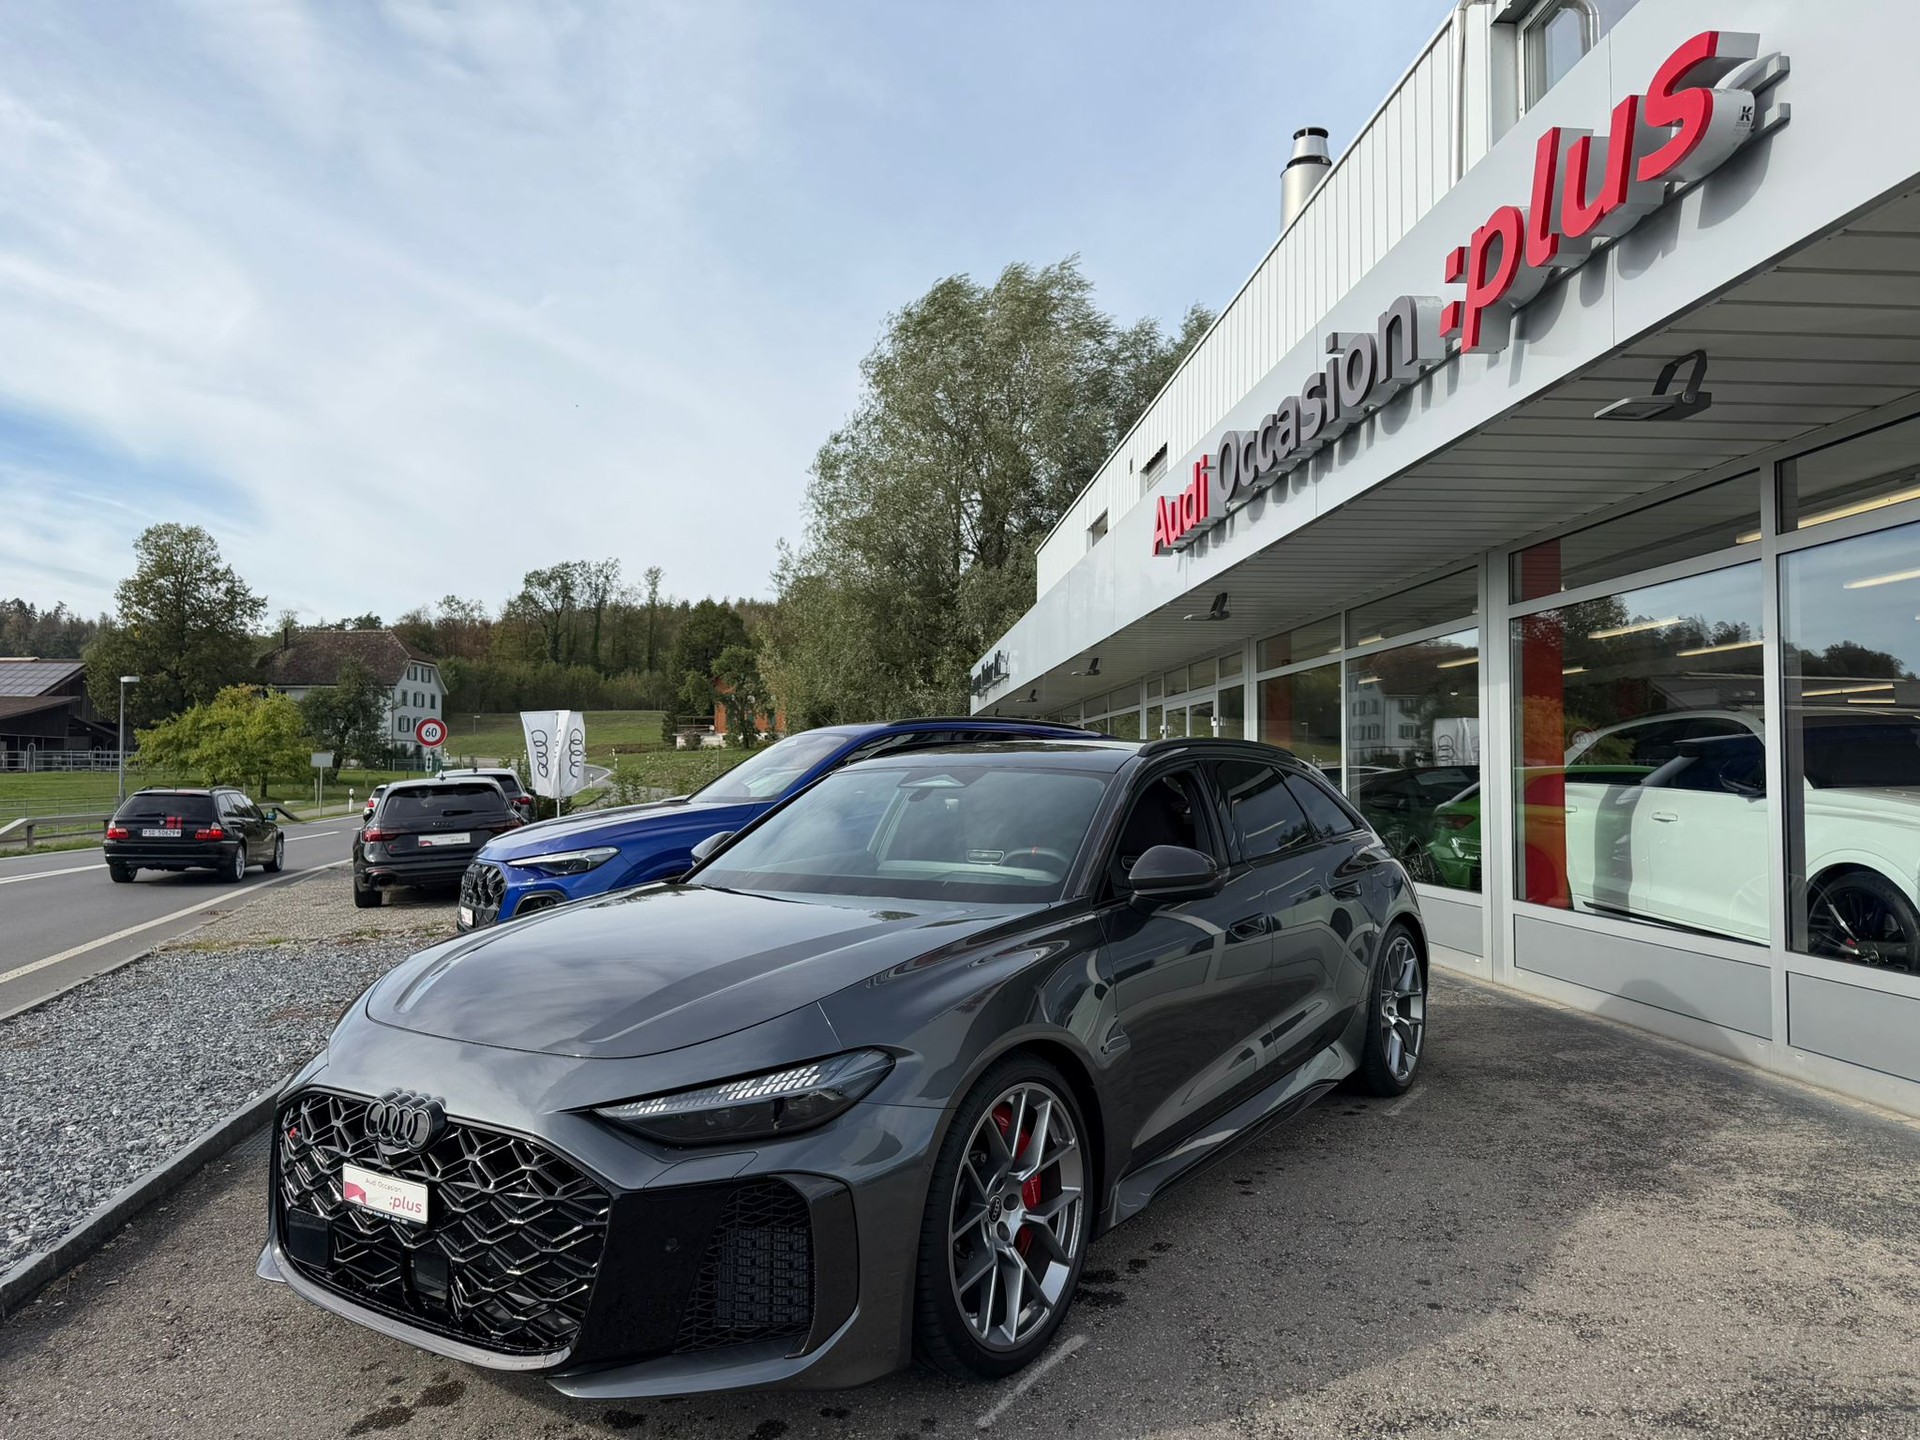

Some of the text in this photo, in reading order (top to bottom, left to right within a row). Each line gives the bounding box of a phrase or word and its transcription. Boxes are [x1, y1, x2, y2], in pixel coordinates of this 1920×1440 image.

[1152, 31, 1721, 557] Audi Occasion :plus
[425, 727, 438, 738] 60
[366, 1178, 402, 1193] Audi Occasion
